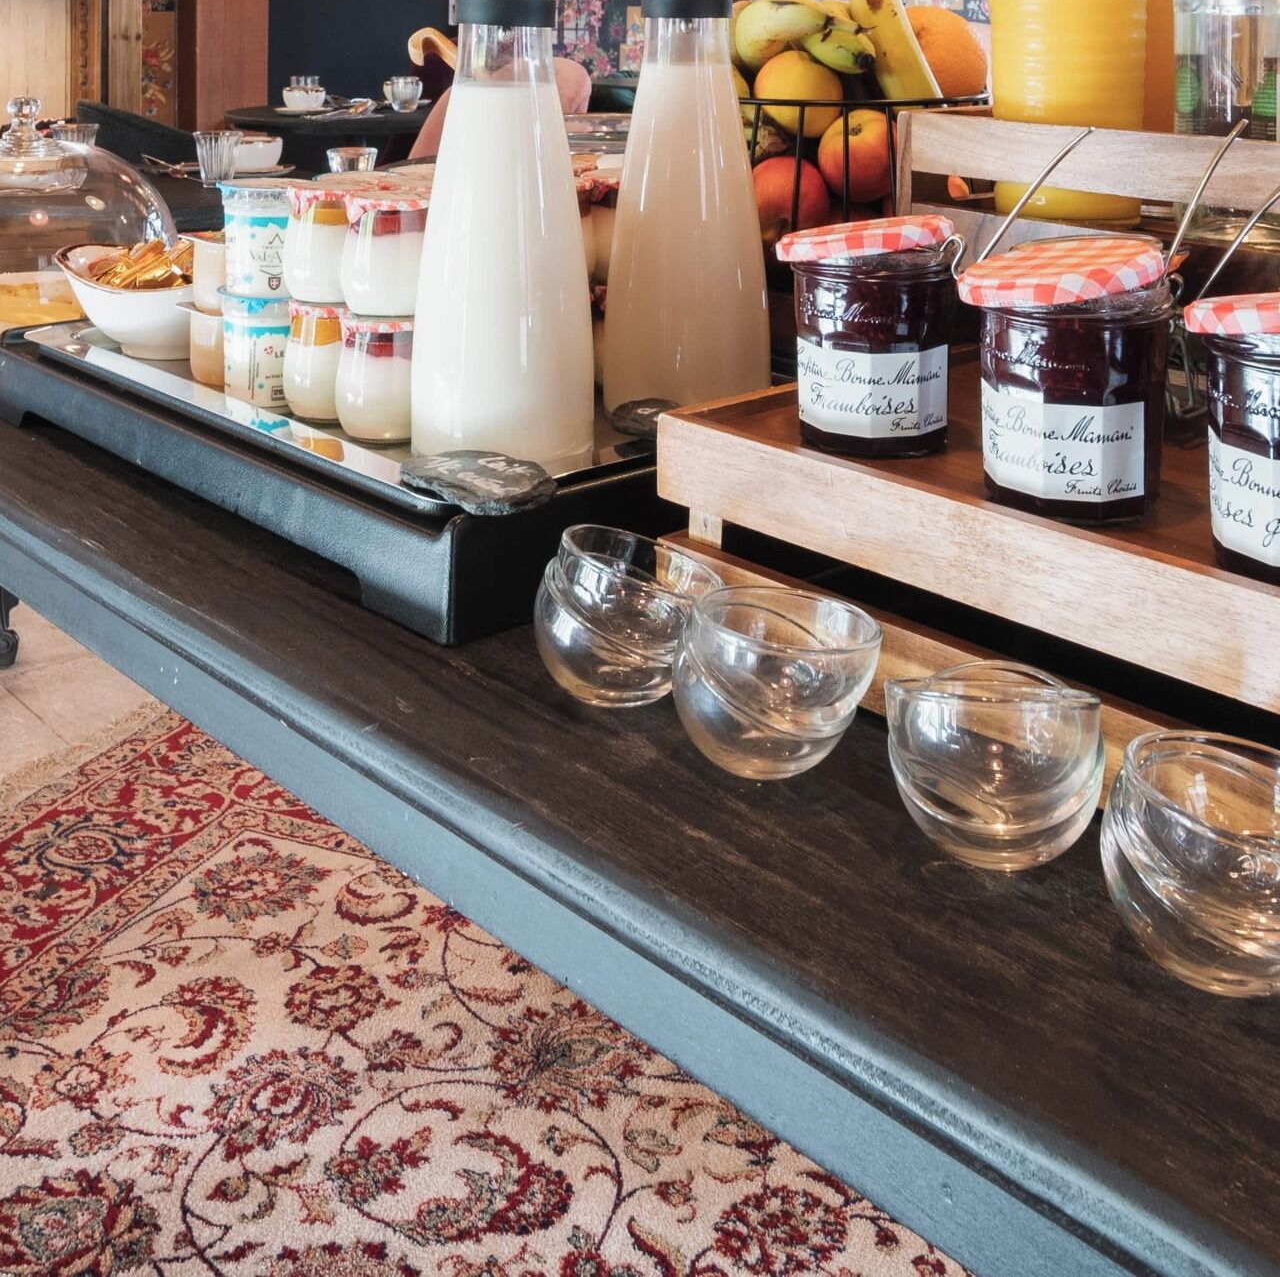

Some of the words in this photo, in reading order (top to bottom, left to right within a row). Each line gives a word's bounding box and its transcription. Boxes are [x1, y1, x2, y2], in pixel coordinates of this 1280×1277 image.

[834, 357, 886, 386] Bonne
[887, 360, 941, 386] Maman
[810, 382, 919, 417] Framboises
[890, 416, 921, 432] Fruits
[1006, 405, 1058, 440] Bonne
[1060, 414, 1133, 444] Maman
[988, 428, 1098, 477] Framboises
[1065, 480, 1103, 496] Fruits
[1106, 479, 1138, 496] Choisis
